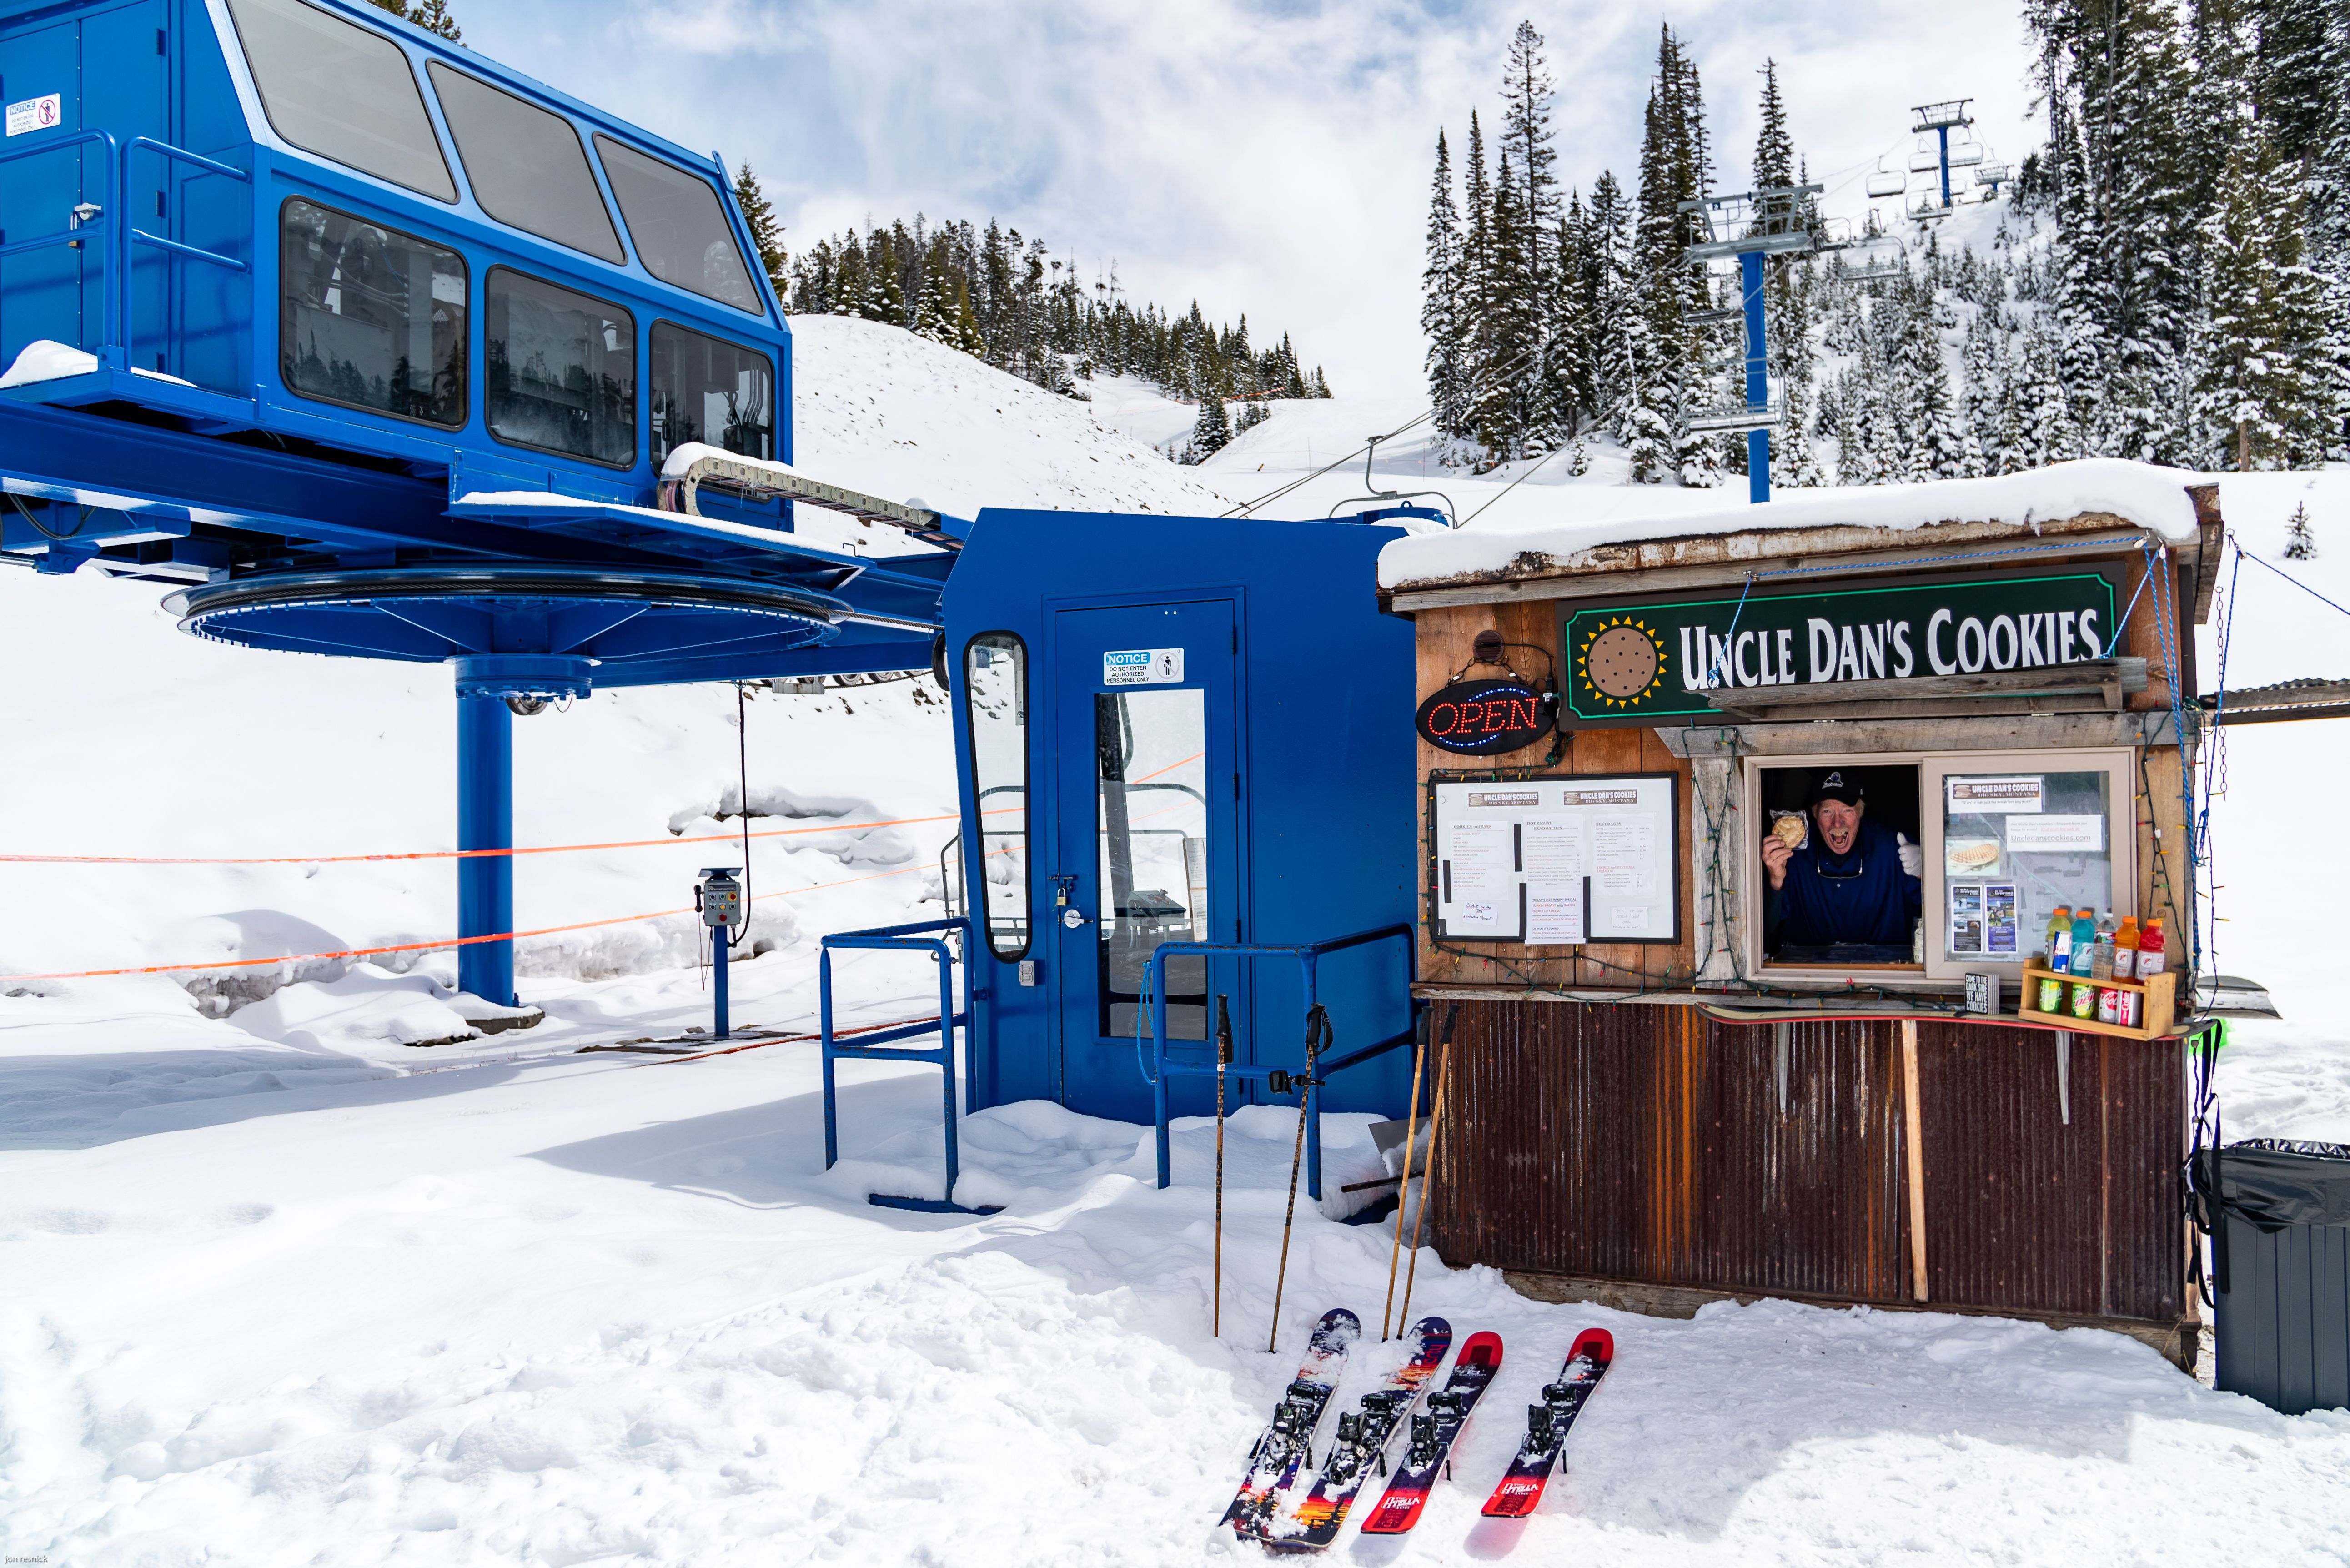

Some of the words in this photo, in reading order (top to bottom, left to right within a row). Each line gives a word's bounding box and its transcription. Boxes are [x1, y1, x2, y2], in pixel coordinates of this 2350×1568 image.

[11, 101, 35, 115] NOTICE
[1679, 625, 1796, 690] UNCLE
[1808, 618, 1913, 682] DAN'S
[1926, 608, 2101, 676] COOKIES
[1108, 654, 1147, 664] NOTICE
[1429, 697, 1538, 736] OPEN
[1966, 982, 1977, 991] DARK
[1978, 983, 1987, 993] SIDE
[1966, 991, 1973, 1001] WE
[1975, 991, 1987, 1003] HAVE
[1966, 1000, 1987, 1013] COOKIES
